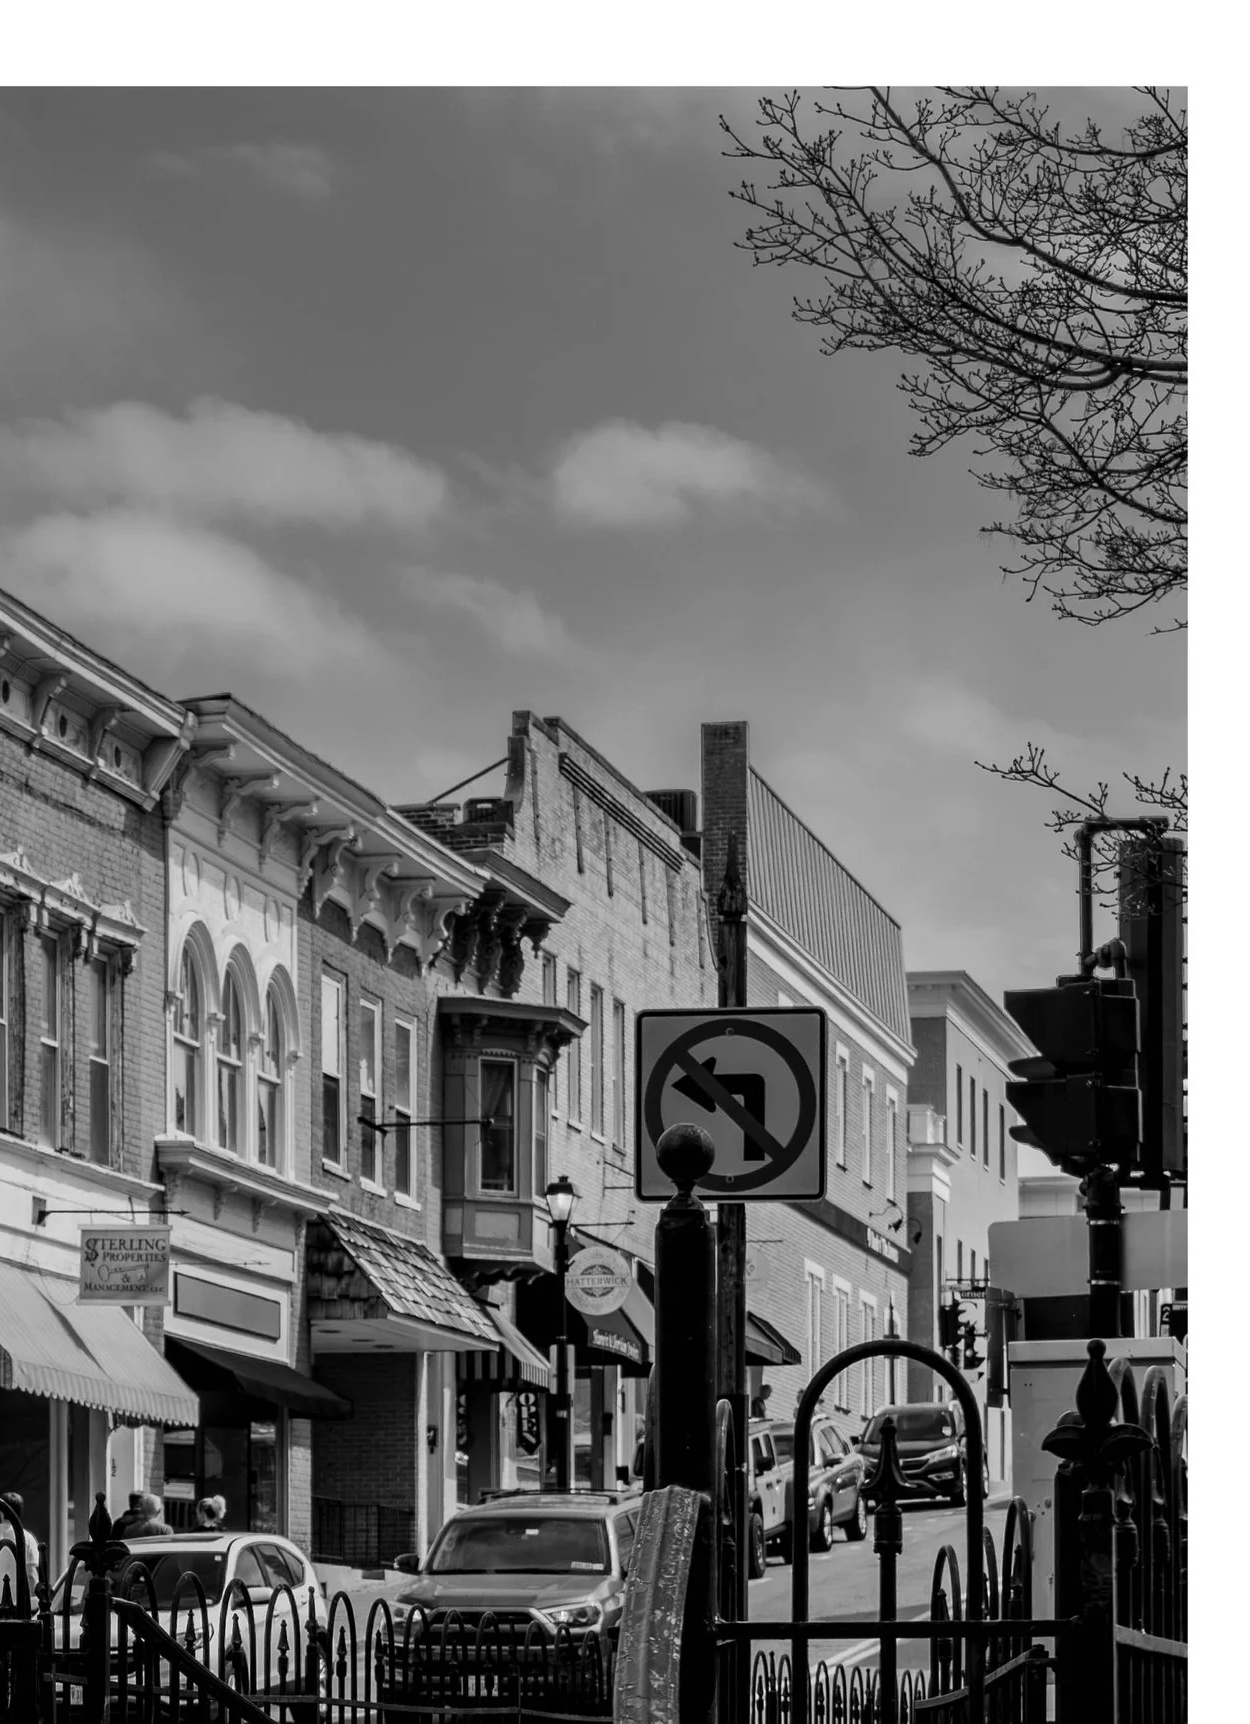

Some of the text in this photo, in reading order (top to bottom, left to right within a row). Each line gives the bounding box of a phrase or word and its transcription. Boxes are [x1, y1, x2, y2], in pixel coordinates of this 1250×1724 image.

[85, 1237, 166, 1264] STERLING
[566, 1275, 628, 1287] HATTERWICK
[1162, 1306, 1171, 1322] 2
